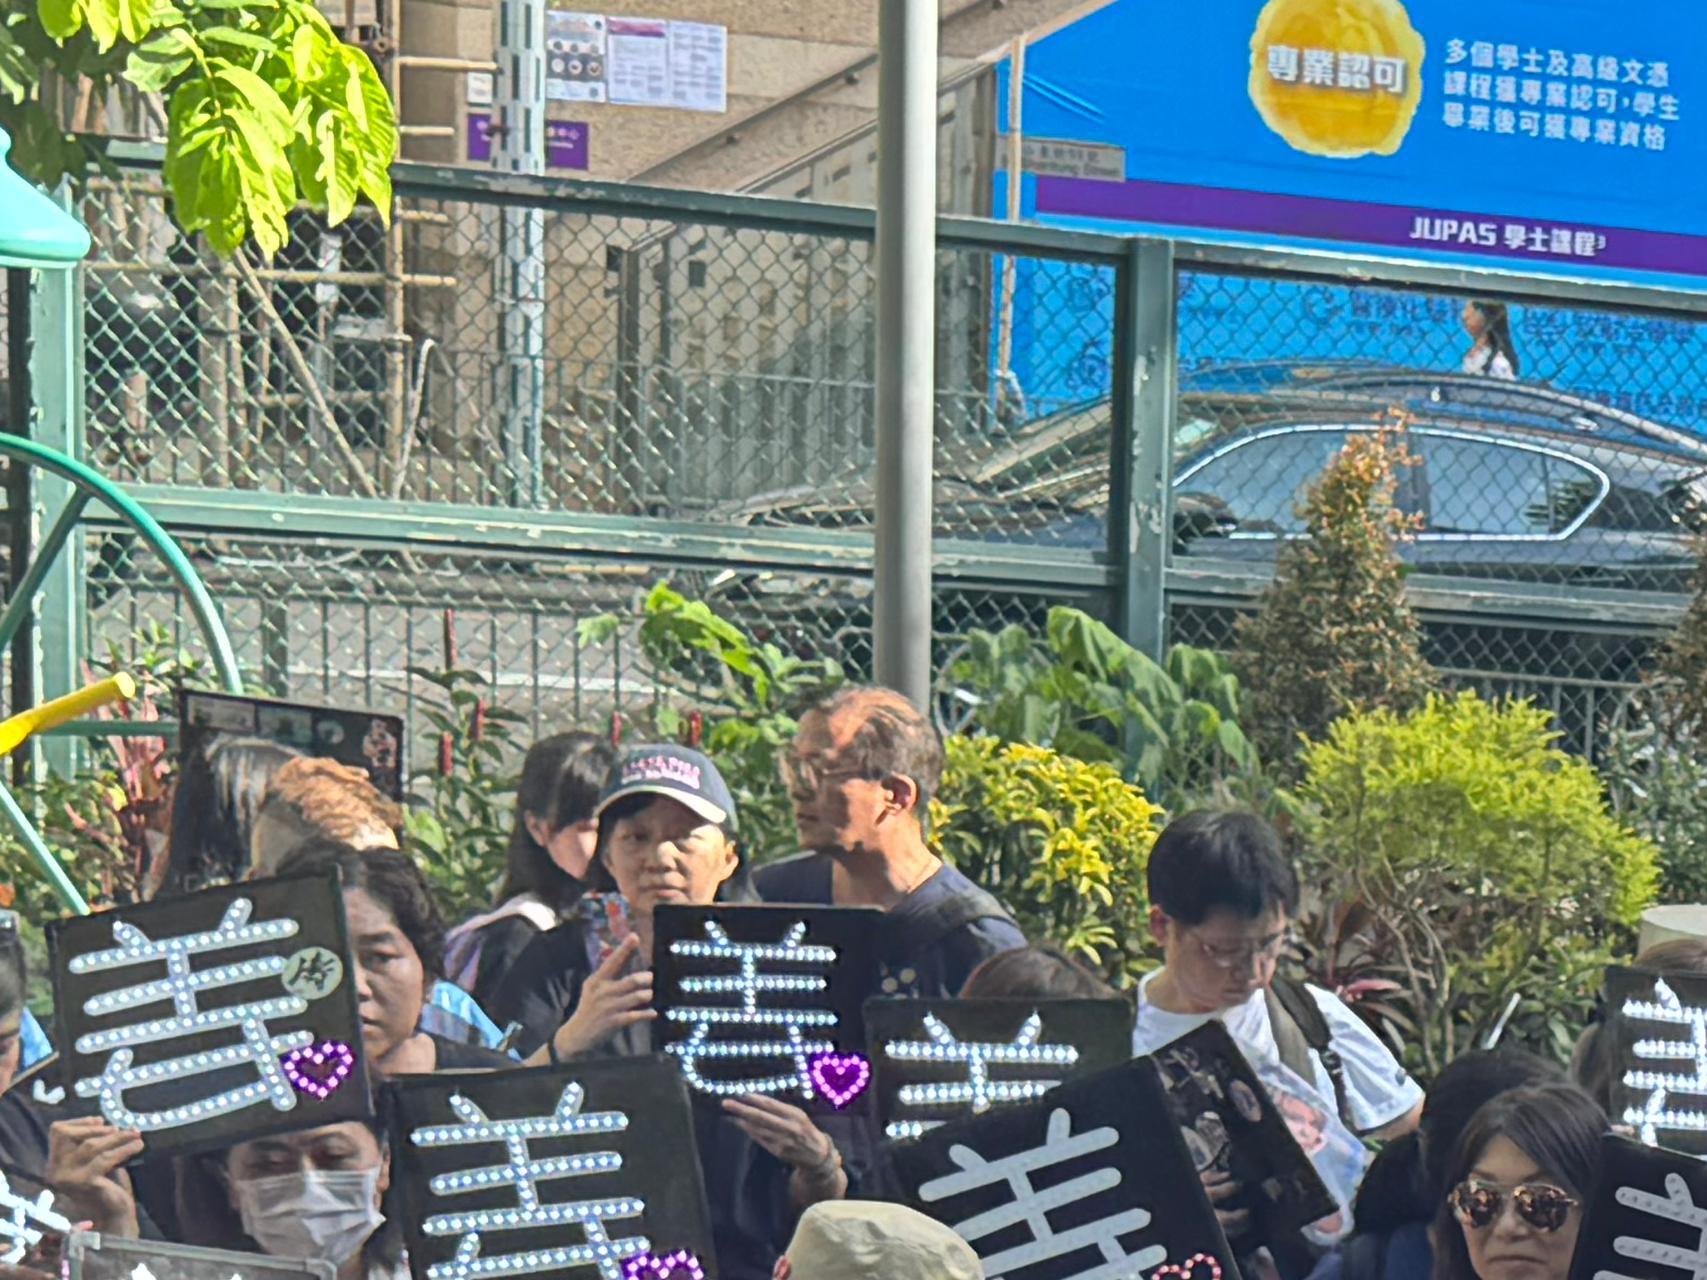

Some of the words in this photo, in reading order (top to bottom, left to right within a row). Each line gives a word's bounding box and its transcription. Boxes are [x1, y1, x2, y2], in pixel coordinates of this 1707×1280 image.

[1267, 45, 1409, 93] 專業認可
[1409, 217, 1497, 247] JUPAS
